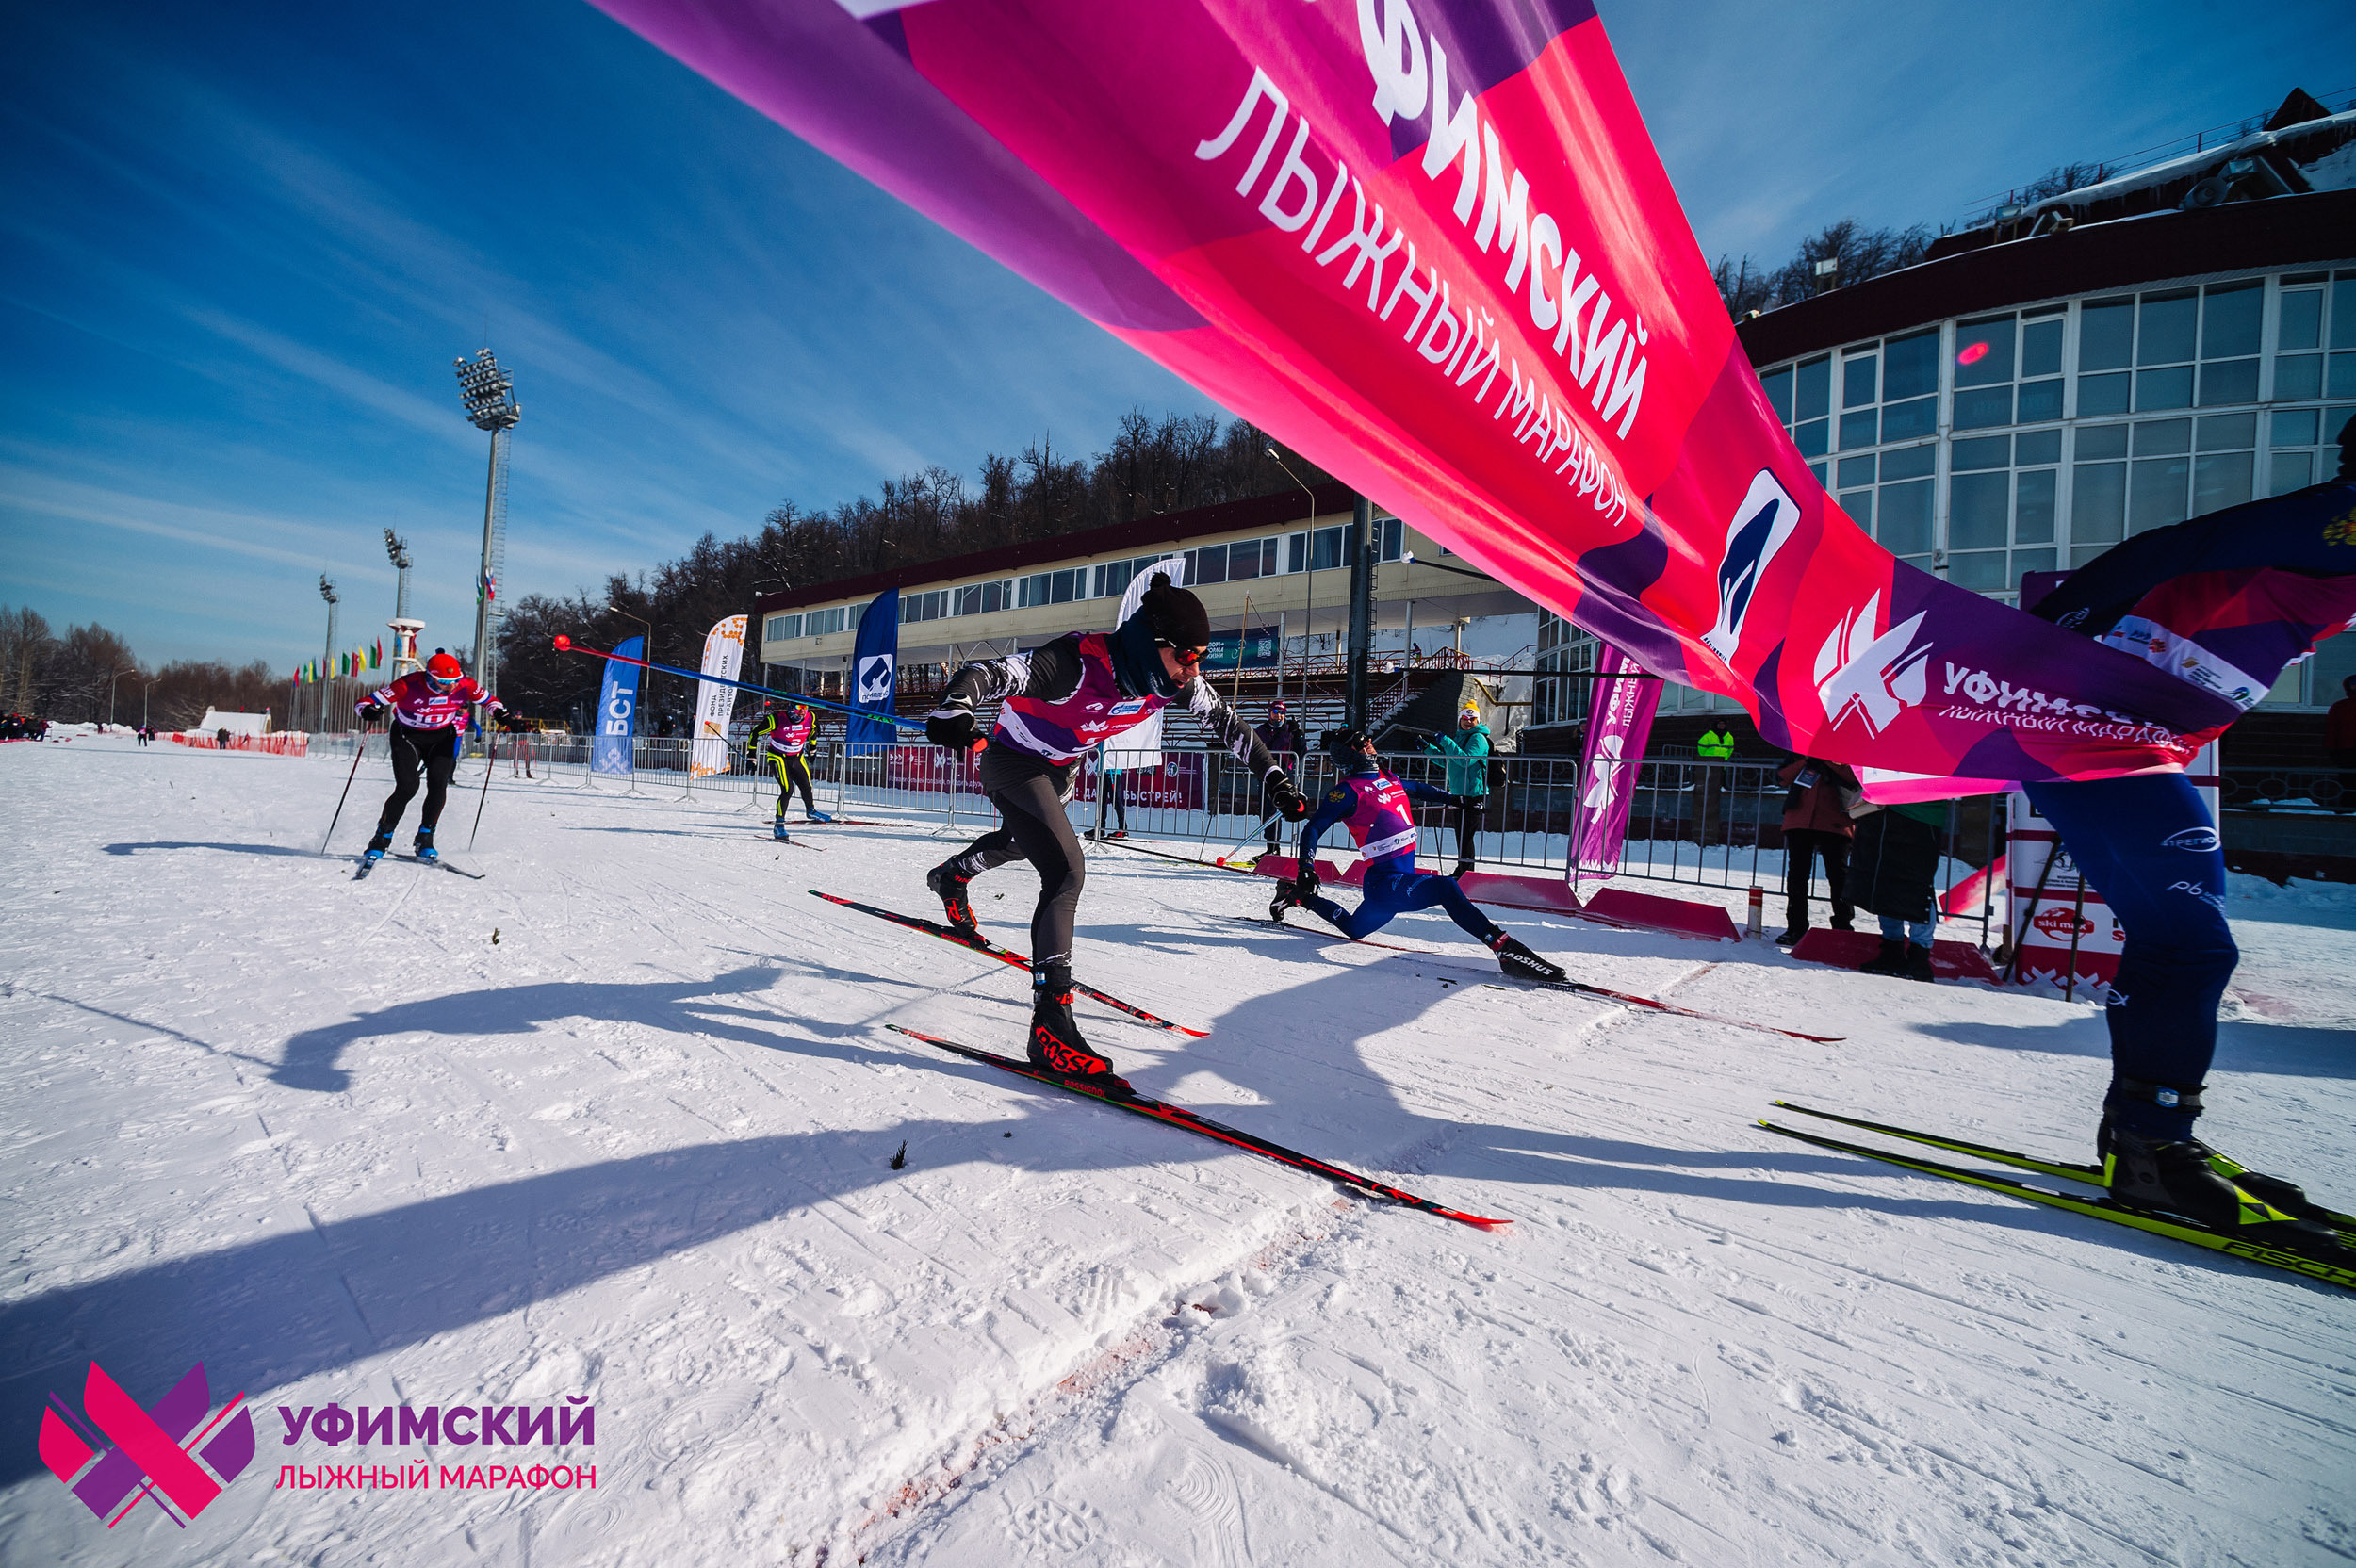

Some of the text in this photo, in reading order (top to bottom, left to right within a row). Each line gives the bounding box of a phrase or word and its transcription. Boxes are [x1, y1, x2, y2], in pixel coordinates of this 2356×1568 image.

[1357, 0, 1647, 440] ФИМСКИЙ
[1194, 65, 1628, 527] ЛЫЖНЫЙ МАРАФОН
[606, 680, 634, 736] БСТ
[717, 654, 728, 717] ПРЕЗИДЕТСКИХ
[1123, 790, 1183, 803] БЫСТРЕЙ!
[1396, 804, 1412, 826] 1
[2038, 920, 2057, 928] ski
[1038, 1030, 1095, 1075] ROSSI
[1064, 1079, 1107, 1099] ROSSIGNOL
